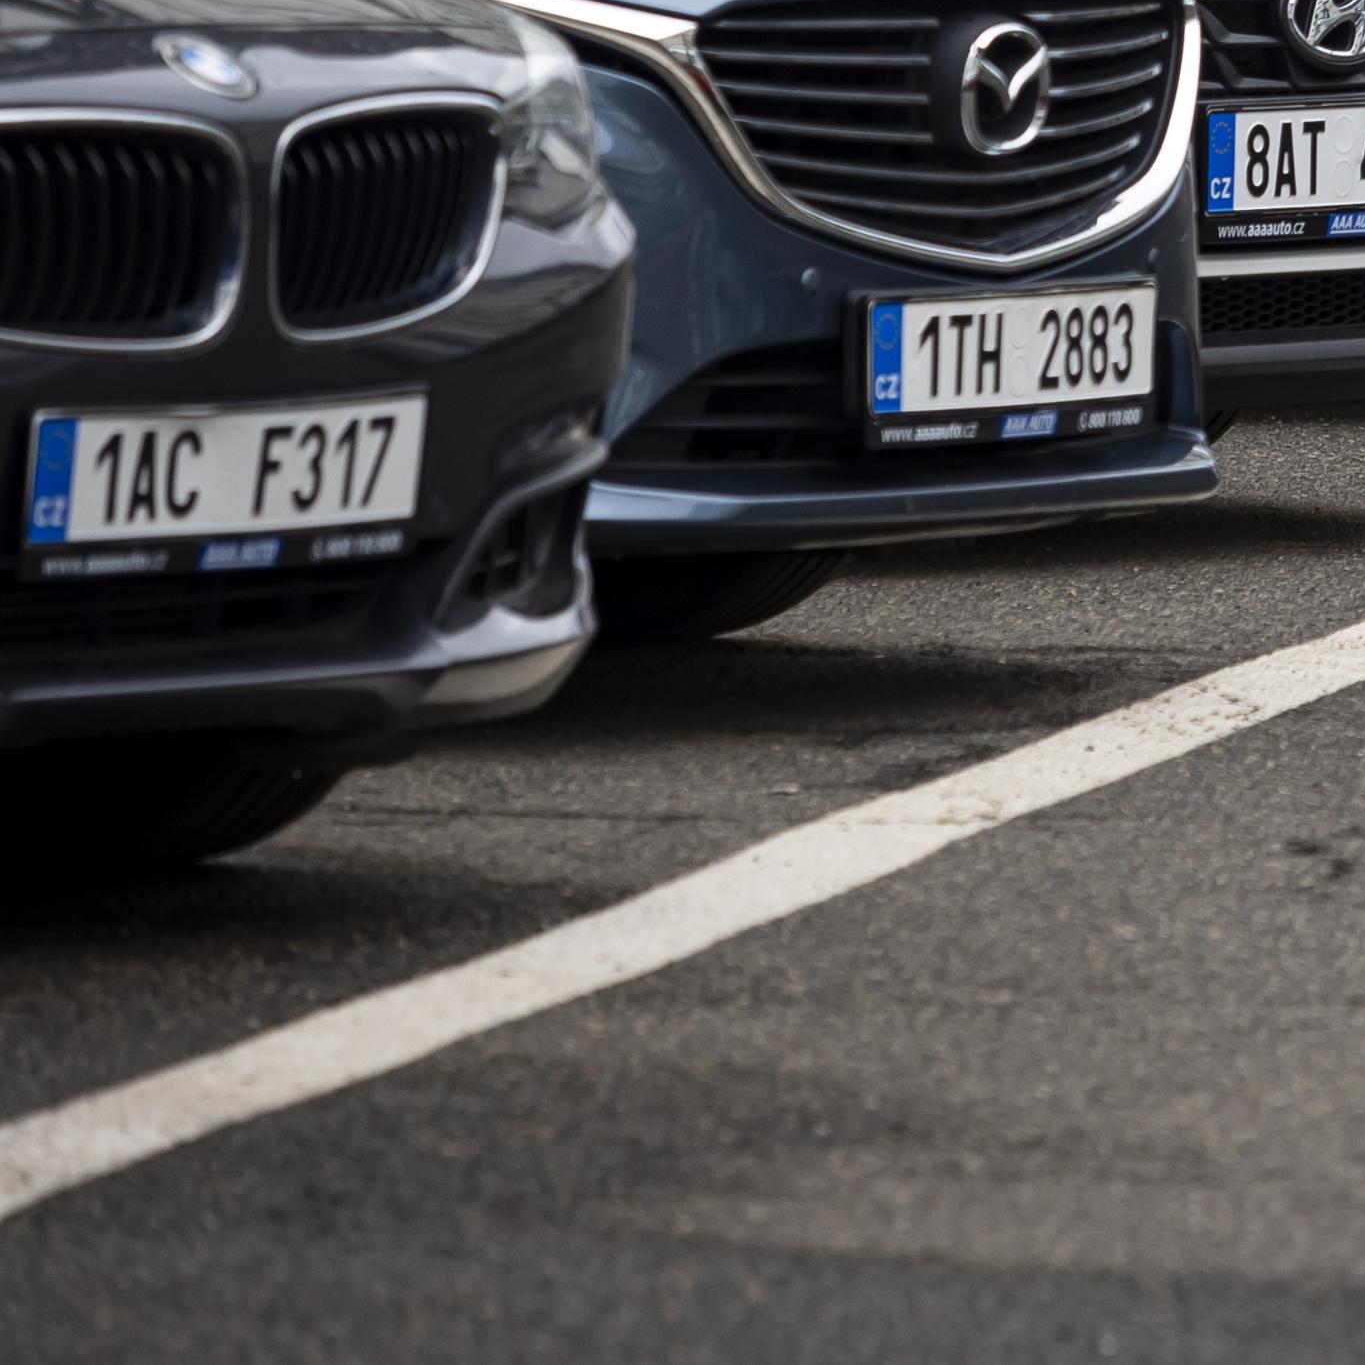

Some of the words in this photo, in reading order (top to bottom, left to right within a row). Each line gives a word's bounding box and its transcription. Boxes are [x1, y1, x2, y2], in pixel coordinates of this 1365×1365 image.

[1210, 177, 1231, 199] CZ
[1246, 120, 1326, 198] 8AT
[1218, 221, 1306, 239] www.aaaauto.cz
[1331, 215, 1353, 230] AAA
[875, 373, 899, 400] CZ
[917, 311, 1004, 398] 1TH
[1039, 303, 1134, 390] 2883
[32, 496, 66, 529] CZ
[96, 430, 201, 526] 1AC
[250, 416, 396, 518] F317
